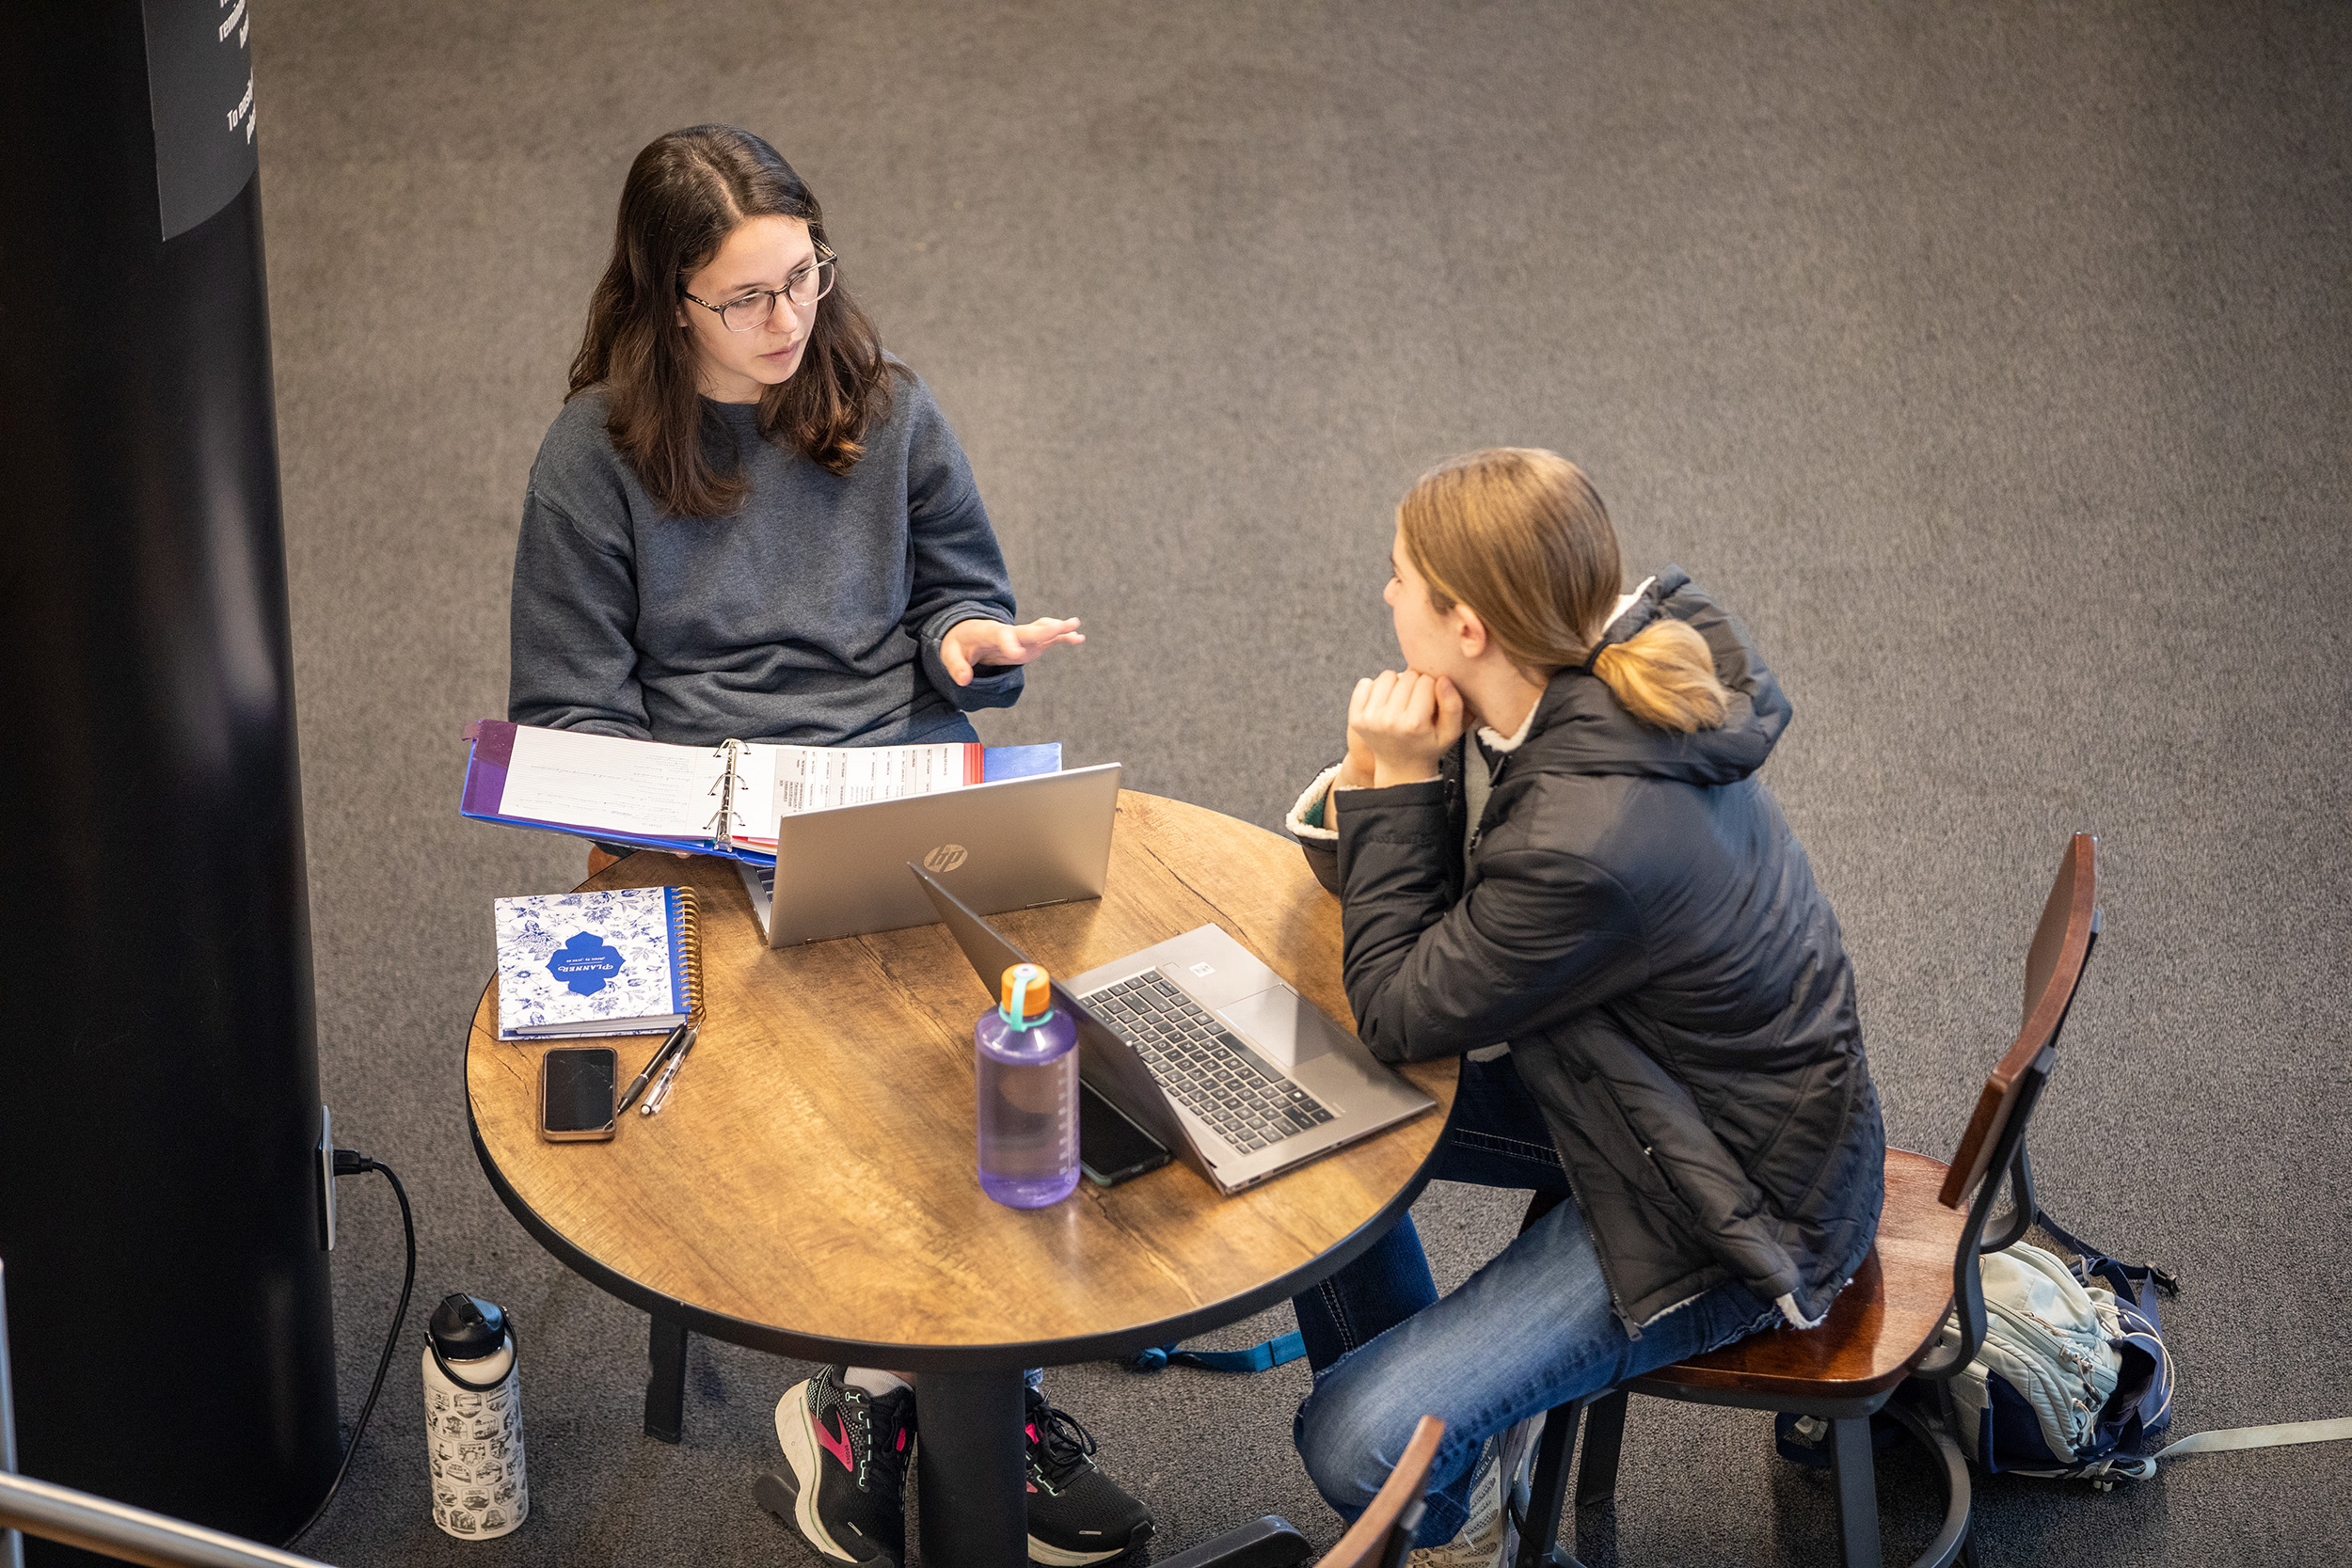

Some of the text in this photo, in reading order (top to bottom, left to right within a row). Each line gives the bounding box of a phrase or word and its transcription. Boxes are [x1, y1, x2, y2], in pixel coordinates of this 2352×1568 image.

[227, 109, 238, 131] To
[925, 844, 968, 873] hp
[557, 963, 613, 973] PLANNER
[1475, 1455, 1493, 1480] RELL
